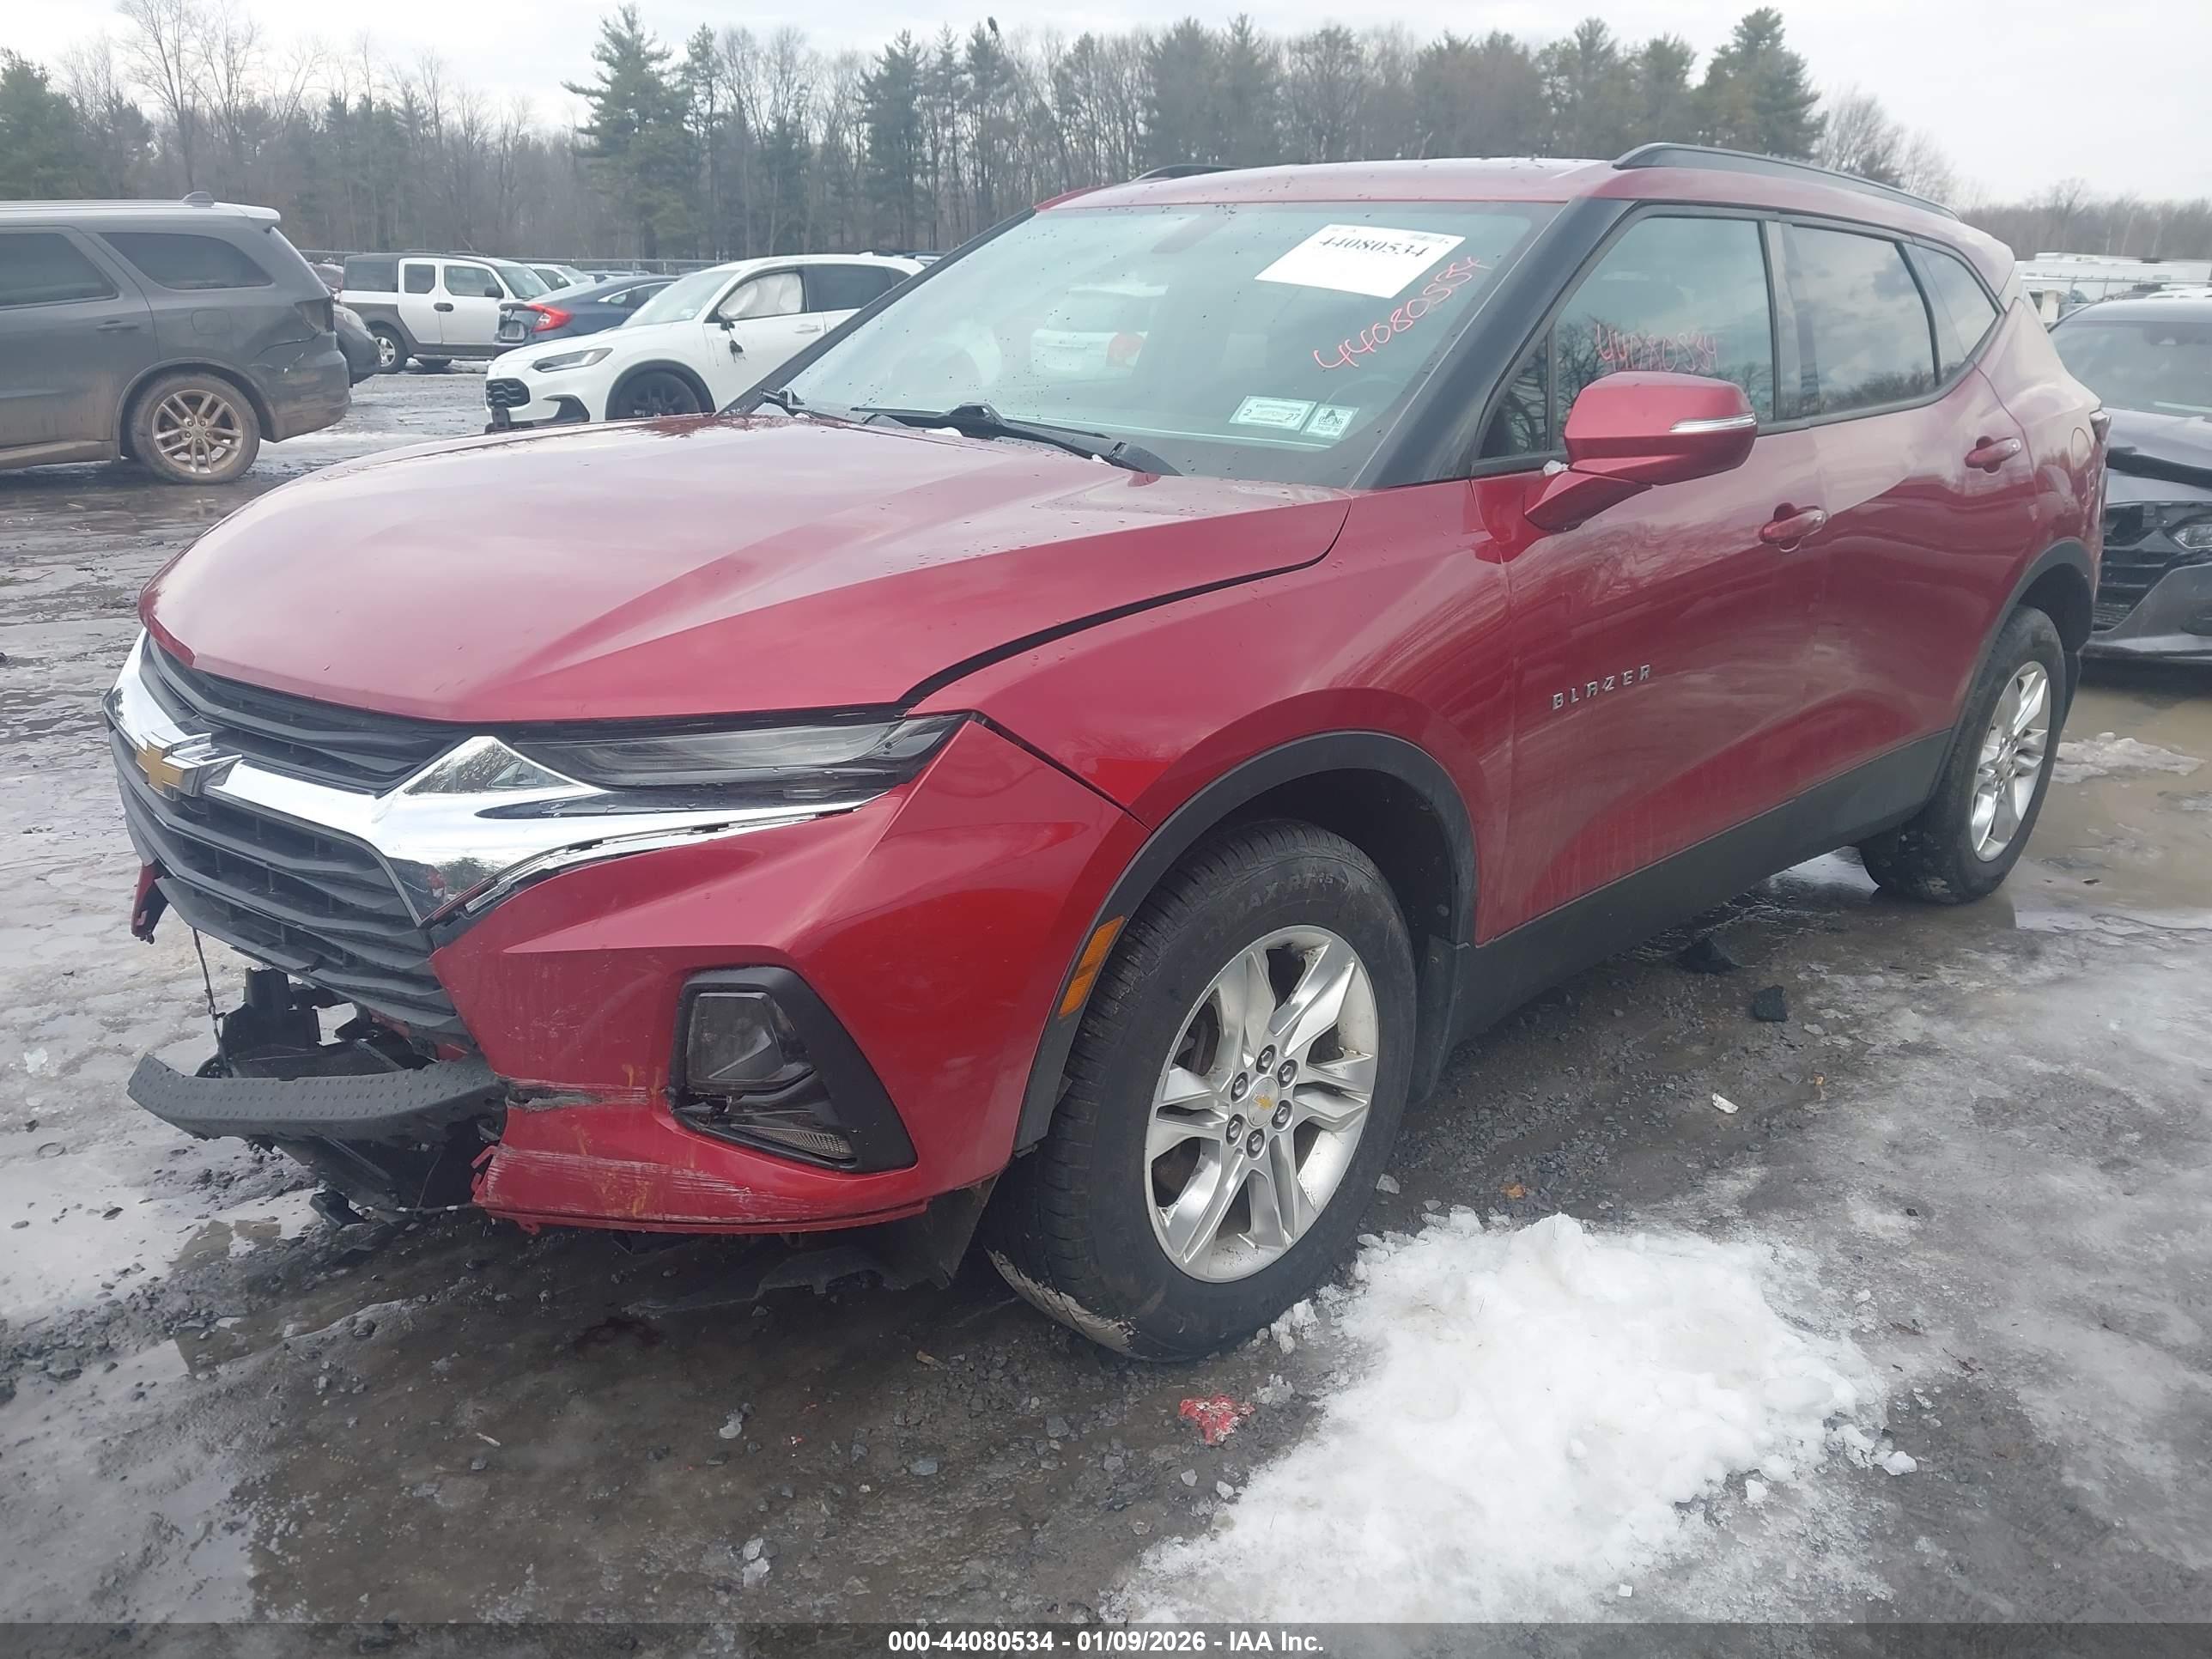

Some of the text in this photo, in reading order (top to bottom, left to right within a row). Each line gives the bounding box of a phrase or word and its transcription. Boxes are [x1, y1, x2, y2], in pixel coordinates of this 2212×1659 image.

[1319, 236, 1430, 257] 44080534
[1313, 257, 1492, 368] 44080534
[1552, 664, 1650, 710] BLAZER
